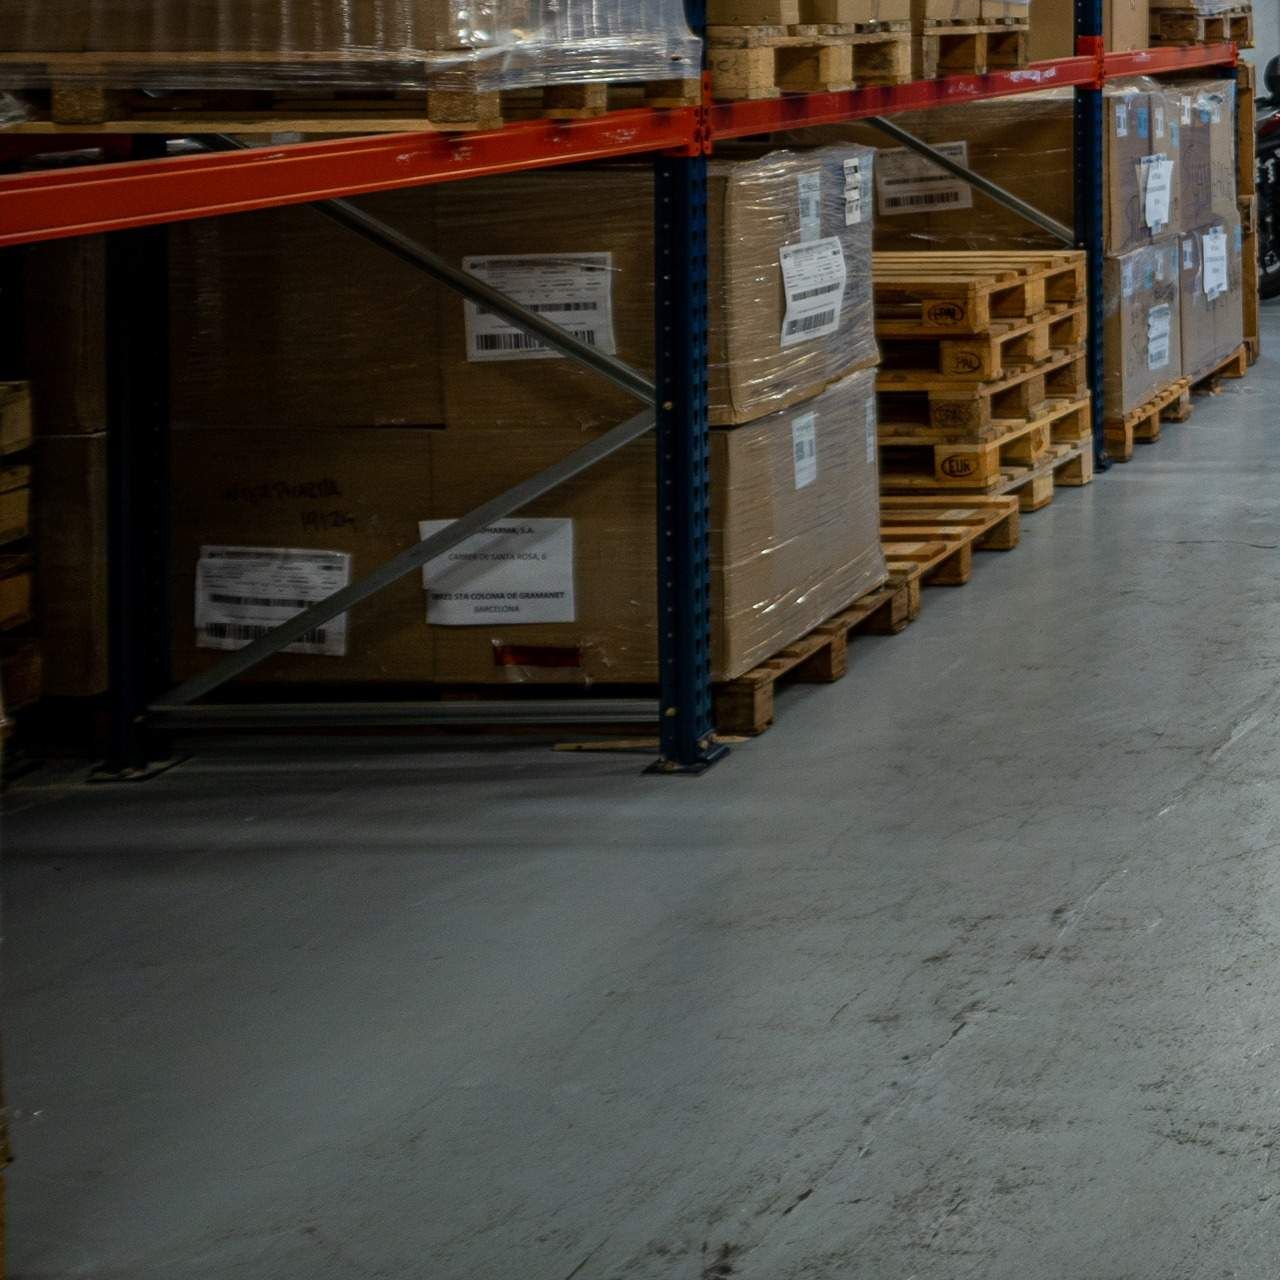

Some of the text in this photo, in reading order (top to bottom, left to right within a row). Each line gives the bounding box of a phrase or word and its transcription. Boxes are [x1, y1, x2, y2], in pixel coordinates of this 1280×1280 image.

[490, 553, 515, 561] SANTA
[454, 592, 469, 600] STA
[470, 592, 505, 600] COLOMA
[507, 592, 518, 600] DE
[473, 605, 520, 613] BARCELONA
